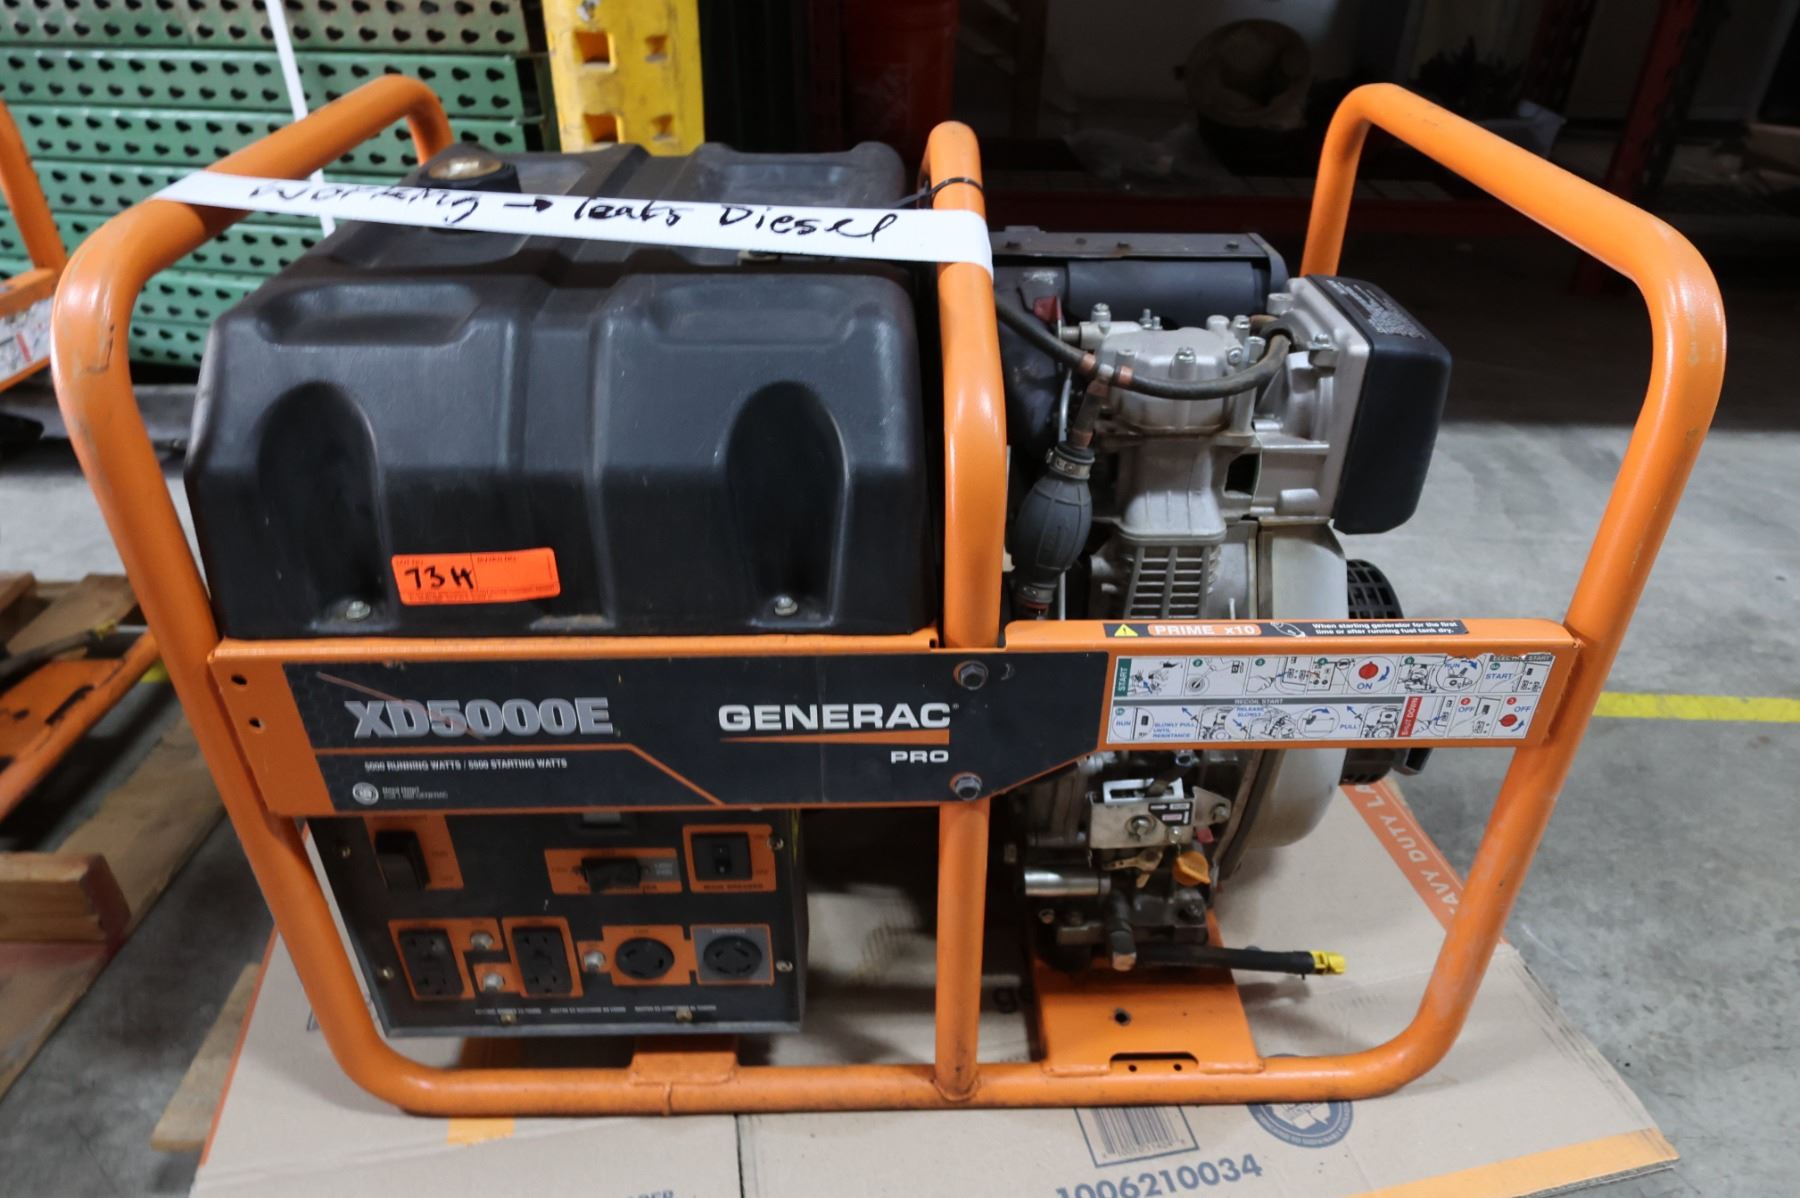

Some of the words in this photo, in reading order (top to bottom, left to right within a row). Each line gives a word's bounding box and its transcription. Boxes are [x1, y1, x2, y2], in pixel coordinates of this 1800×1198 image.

[720, 204, 898, 242] Diesel
[1154, 624, 1215, 635] PRIME
[1224, 624, 1255, 635] x10
[1117, 667, 1128, 692] START
[1357, 682, 1373, 691] ON
[344, 697, 613, 739] XD5000E
[718, 703, 951, 731] GENERAC
[1514, 705, 1531, 713] OFF
[387, 760, 429, 772] RUNNING
[430, 760, 461, 771] WATTS
[490, 758, 535, 770] STARTING
[537, 757, 568, 769] WATTS
[890, 750, 949, 764] PRO
[1379, 815, 1429, 862] DUTY
